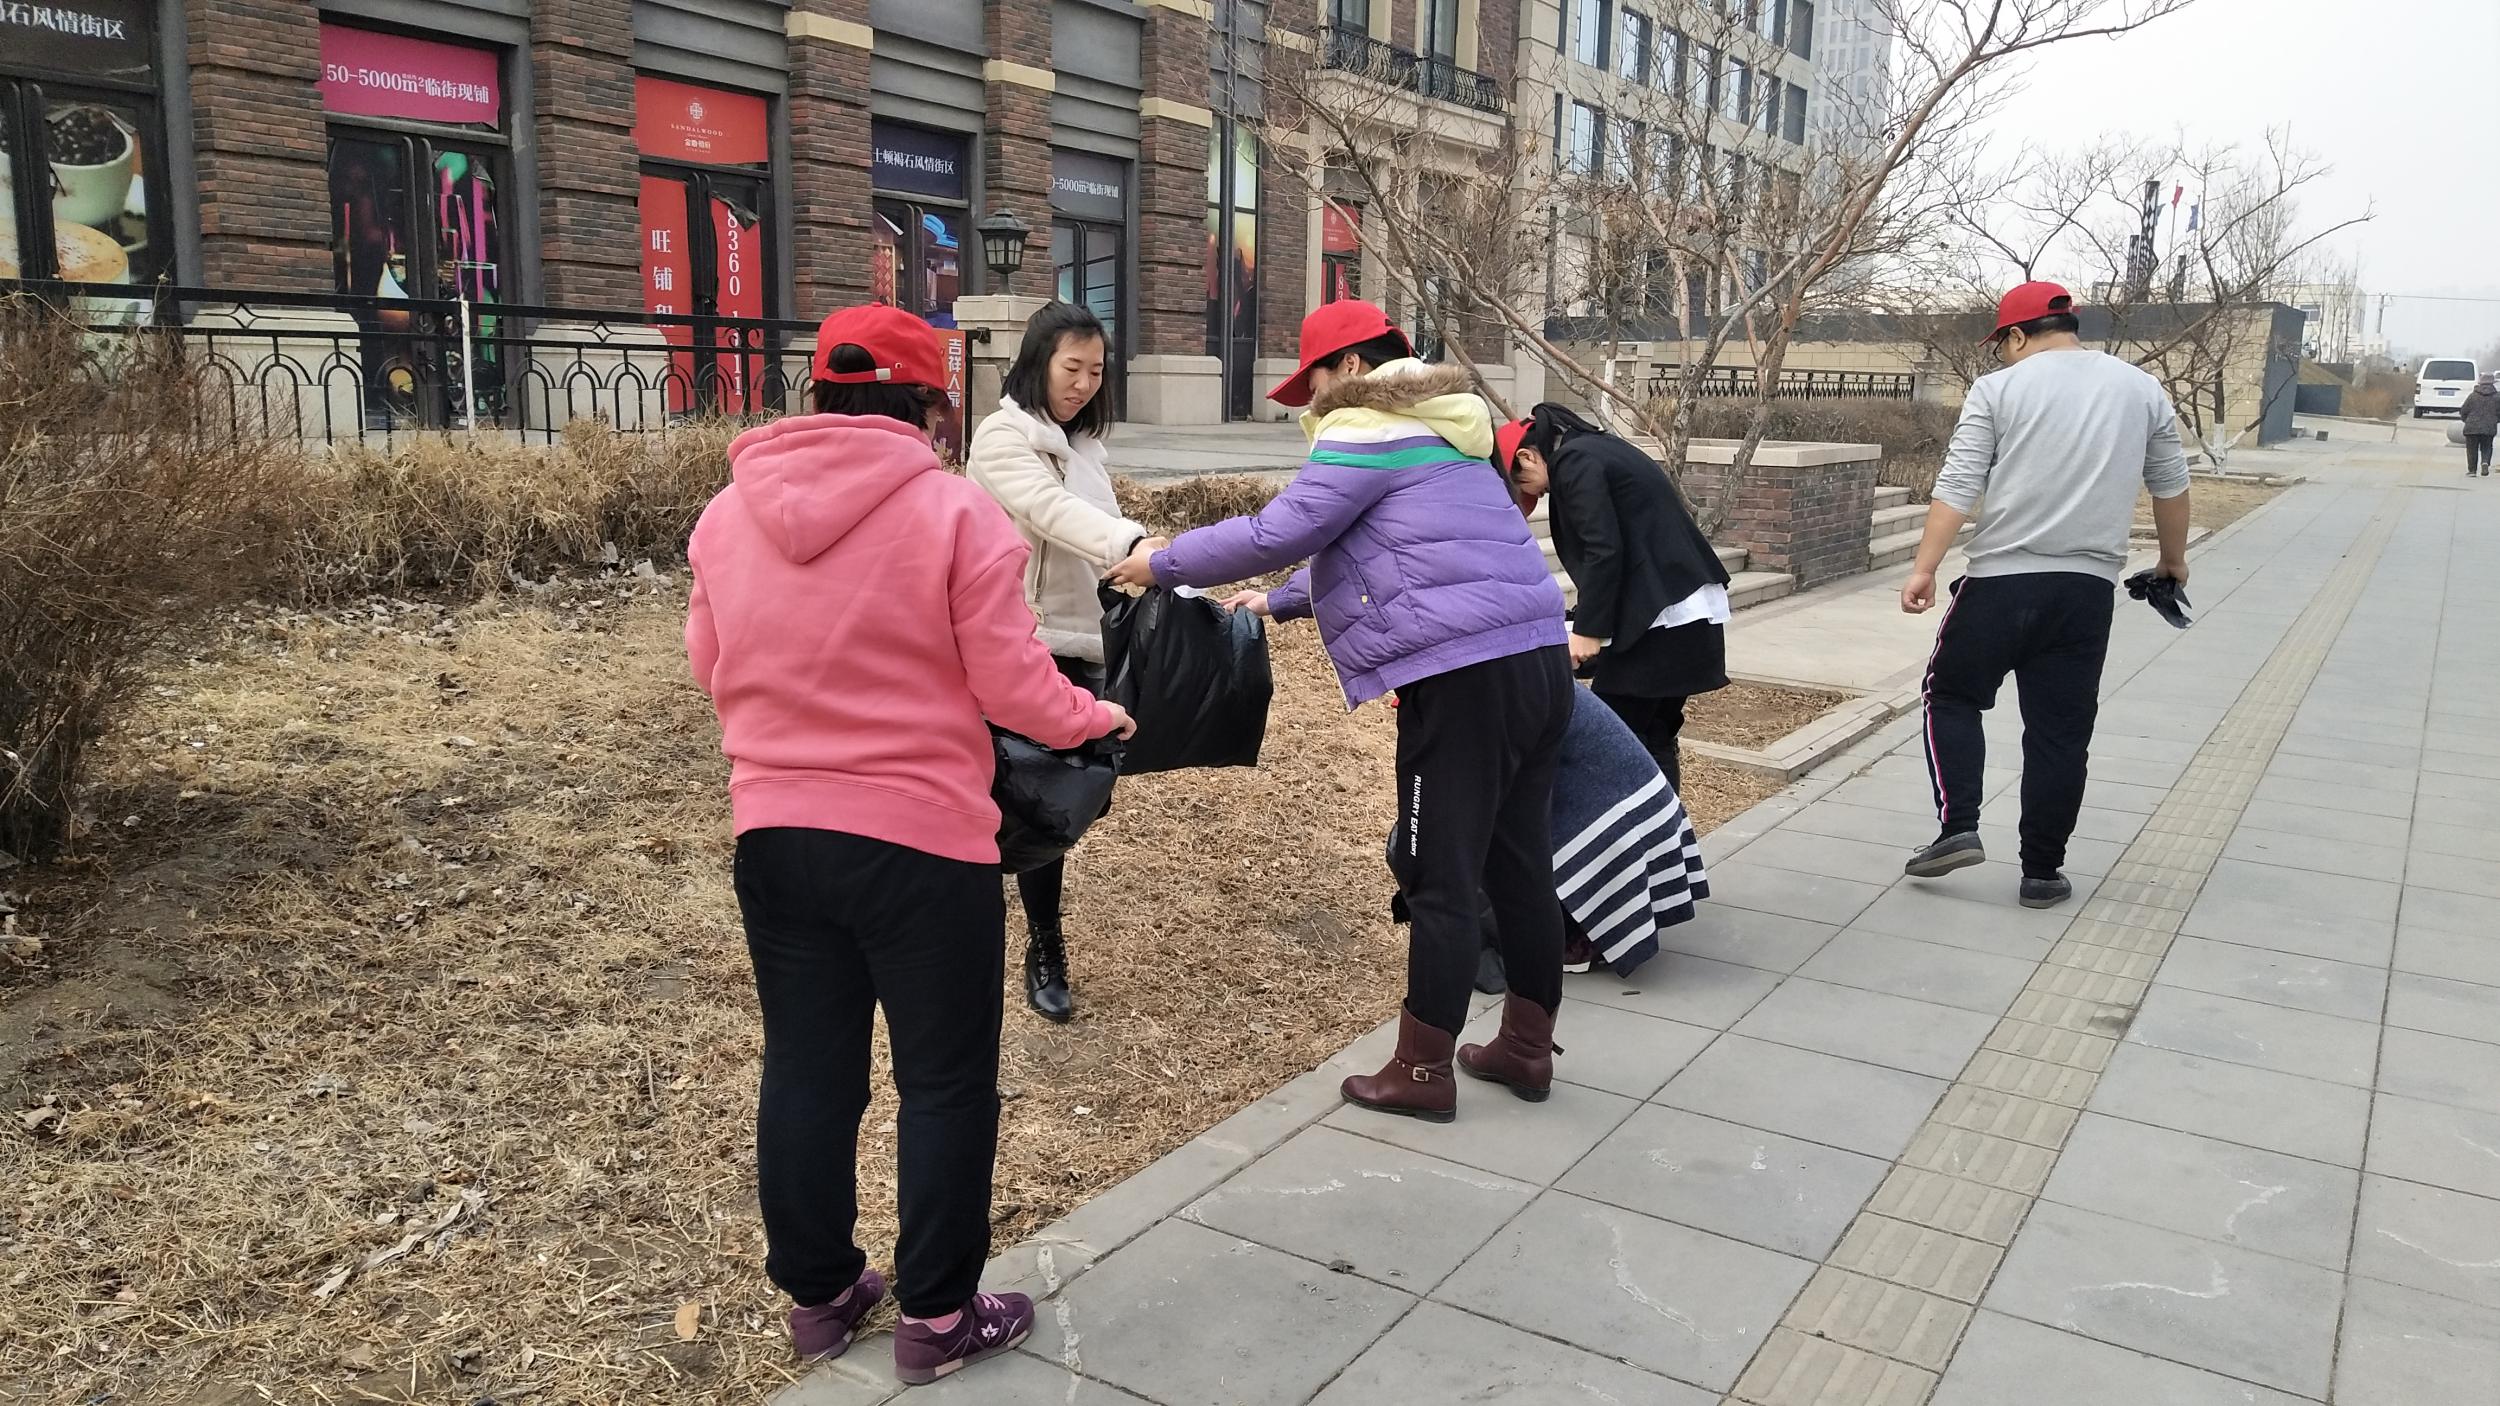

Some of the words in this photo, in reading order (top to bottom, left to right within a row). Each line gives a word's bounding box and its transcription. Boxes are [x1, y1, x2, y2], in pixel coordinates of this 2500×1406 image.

[0, 0, 126, 41] 石风情街区
[670, 123, 724, 137] SANDALWOOD
[873, 147, 954, 175] 士顿褐石风情街区
[727, 208, 741, 296] 8360
[947, 338, 962, 408] 吉祥人家
[1412, 775, 1422, 816] RUNGRY
